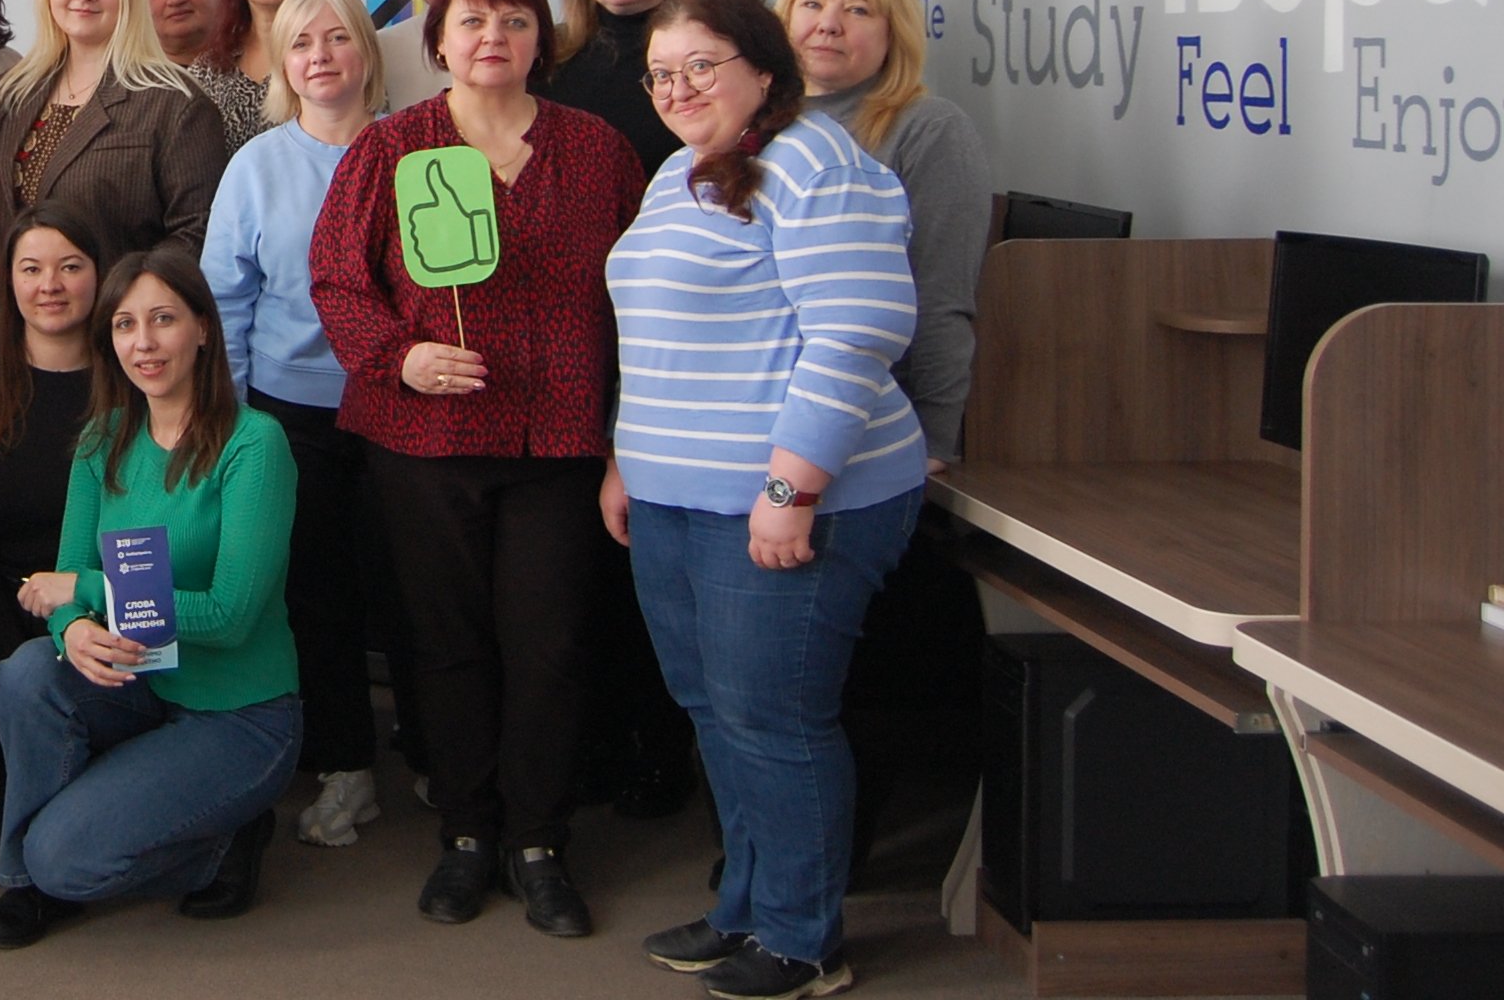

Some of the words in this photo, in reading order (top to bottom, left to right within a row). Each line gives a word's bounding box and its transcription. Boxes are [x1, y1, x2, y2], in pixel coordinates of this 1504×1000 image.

[1176, 35, 1291, 136] Feel
[1352, 37, 1504, 187] Enjo
[124, 610, 158, 620] МАЮТЬ
[125, 600, 155, 610] СЛОВА
